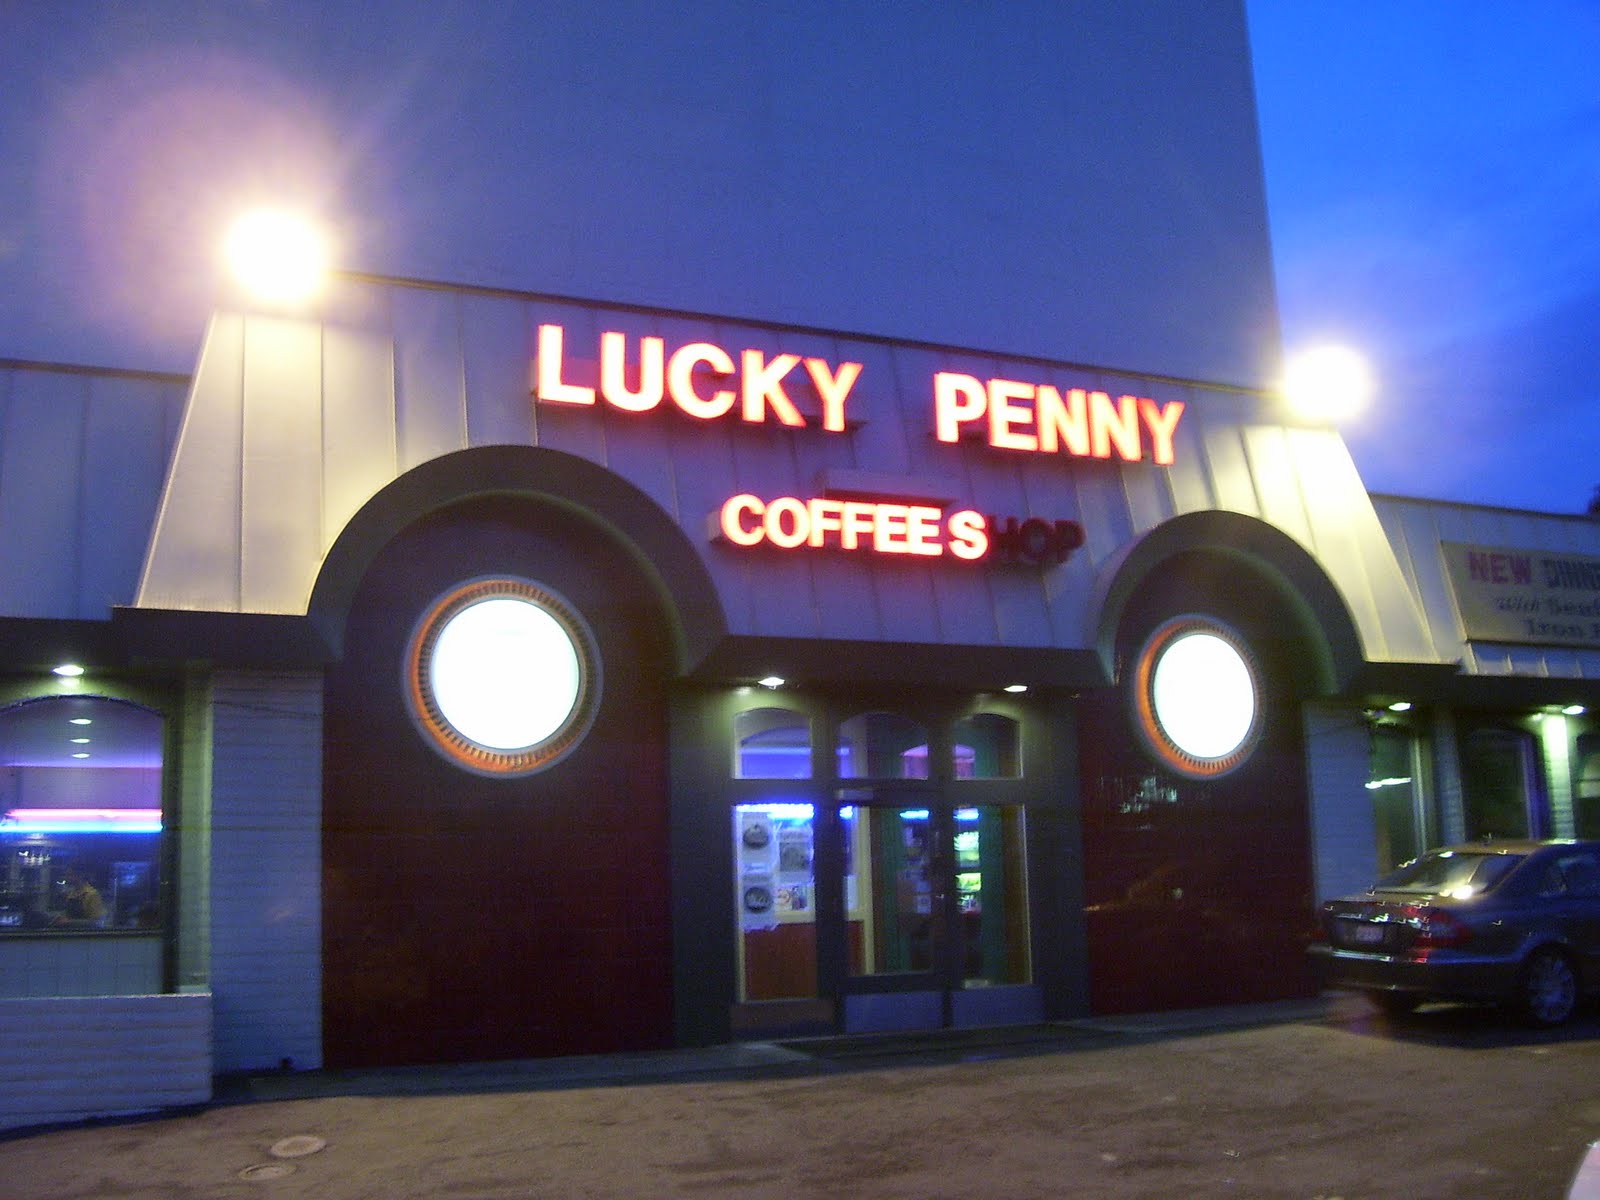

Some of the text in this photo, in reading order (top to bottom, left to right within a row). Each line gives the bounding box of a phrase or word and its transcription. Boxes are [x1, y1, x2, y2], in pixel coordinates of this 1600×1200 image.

[535, 322, 1186, 466] LUCKY PENNY
[719, 492, 944, 557] COFFEE
[1468, 550, 1532, 586] NEW
